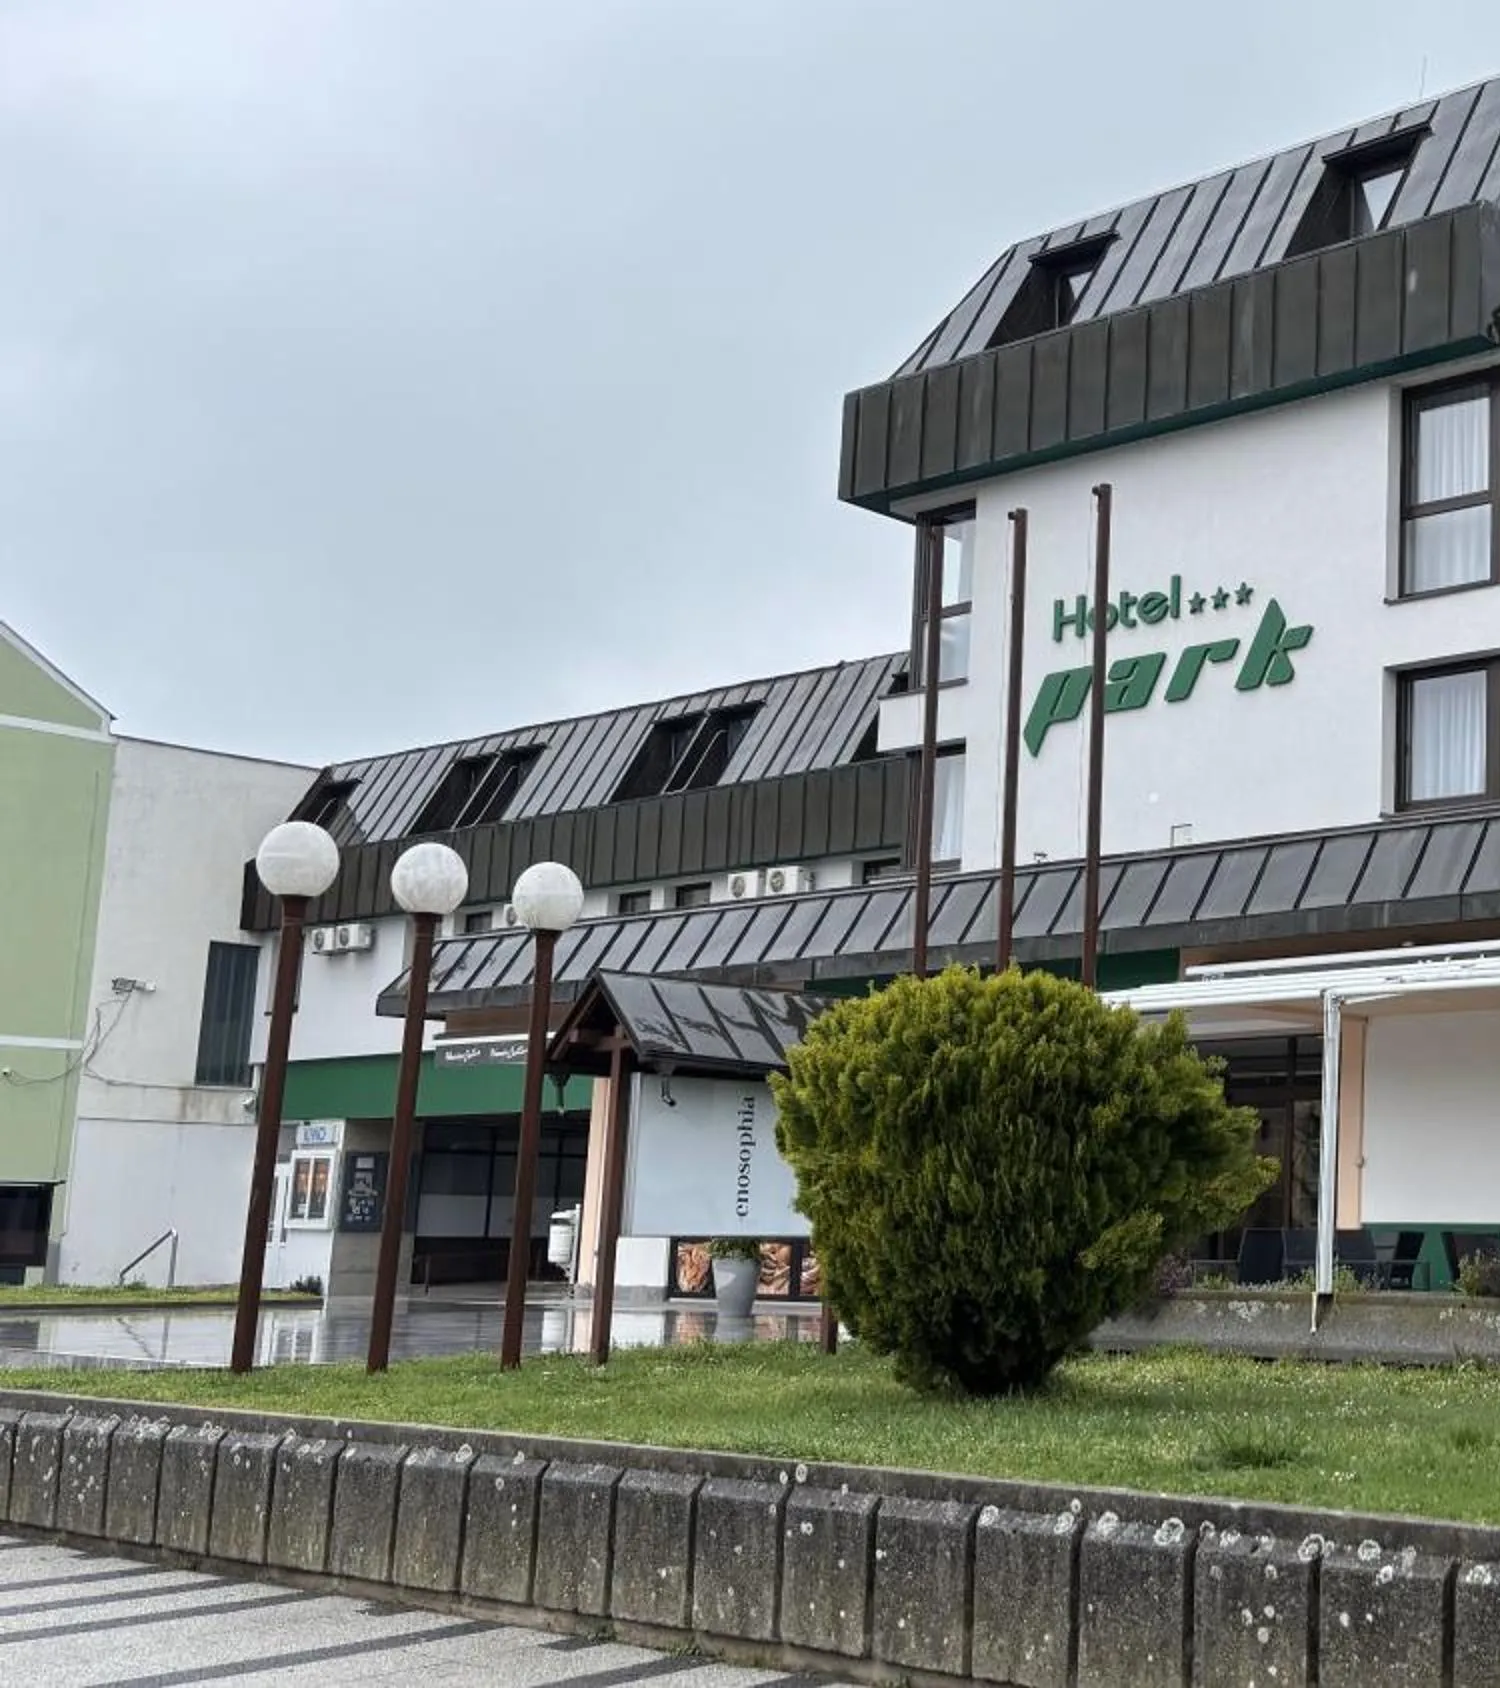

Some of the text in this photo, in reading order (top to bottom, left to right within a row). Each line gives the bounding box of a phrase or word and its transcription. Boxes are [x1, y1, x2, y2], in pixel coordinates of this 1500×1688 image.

[1052, 574, 1182, 643] Hotel
[1023, 598, 1314, 757] park
[736, 1096, 756, 1218] enosophia
